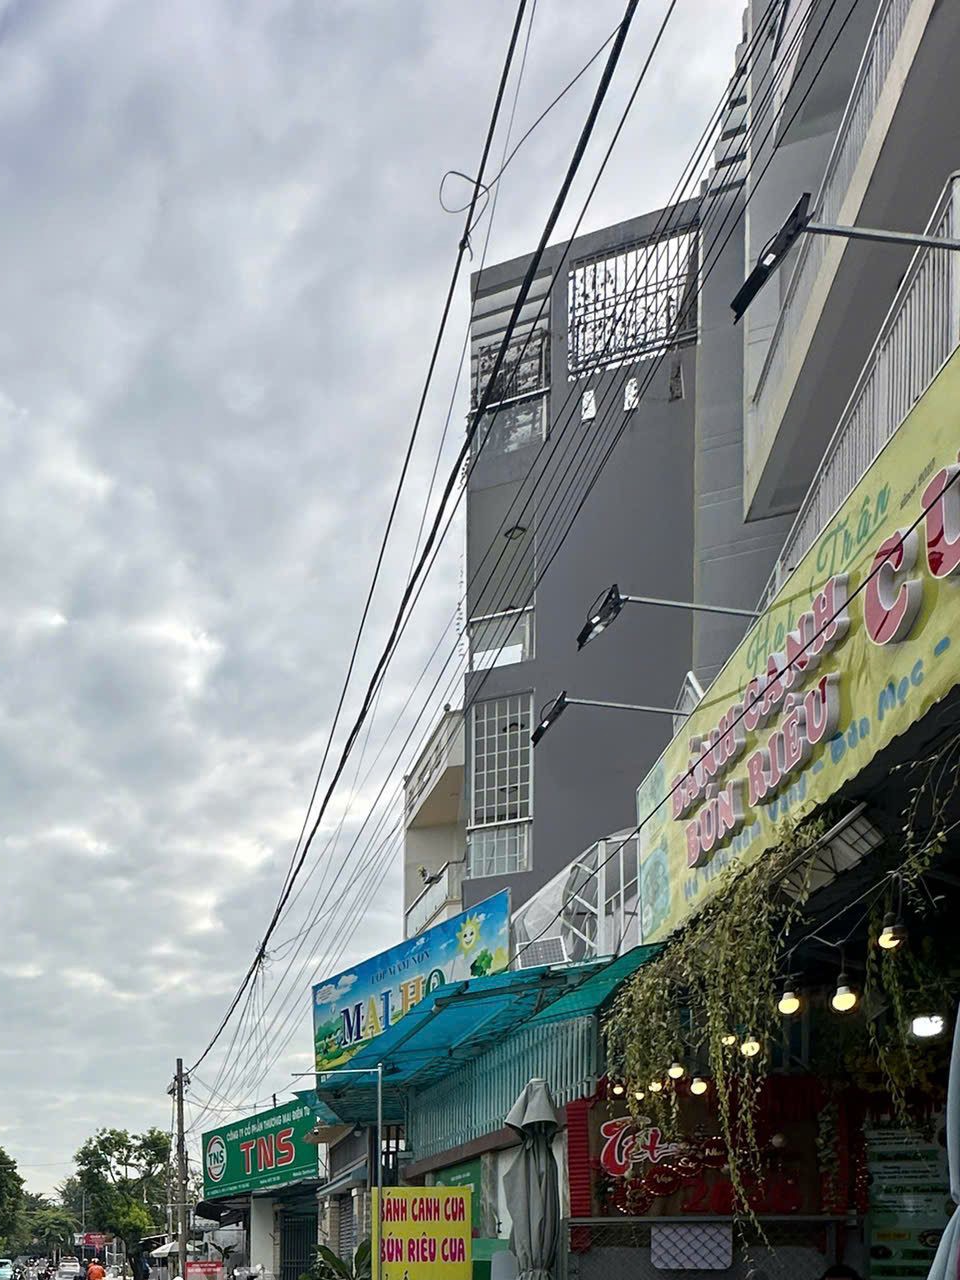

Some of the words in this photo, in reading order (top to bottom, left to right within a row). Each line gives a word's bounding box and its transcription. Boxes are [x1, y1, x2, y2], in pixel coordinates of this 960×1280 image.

[671, 703, 740, 821] BÁNH
[743, 573, 839, 732] CANH
[685, 779, 738, 869] BÚN
[746, 674, 831, 808] RIÊU
[208, 1149, 225, 1167] TNS
[240, 1126, 296, 1175] TNS
[411, 1197, 440, 1222] CANH
[444, 1196, 465, 1222] CUA
[408, 1231, 437, 1263] RIÊU
[441, 1237, 465, 1262] CUA
